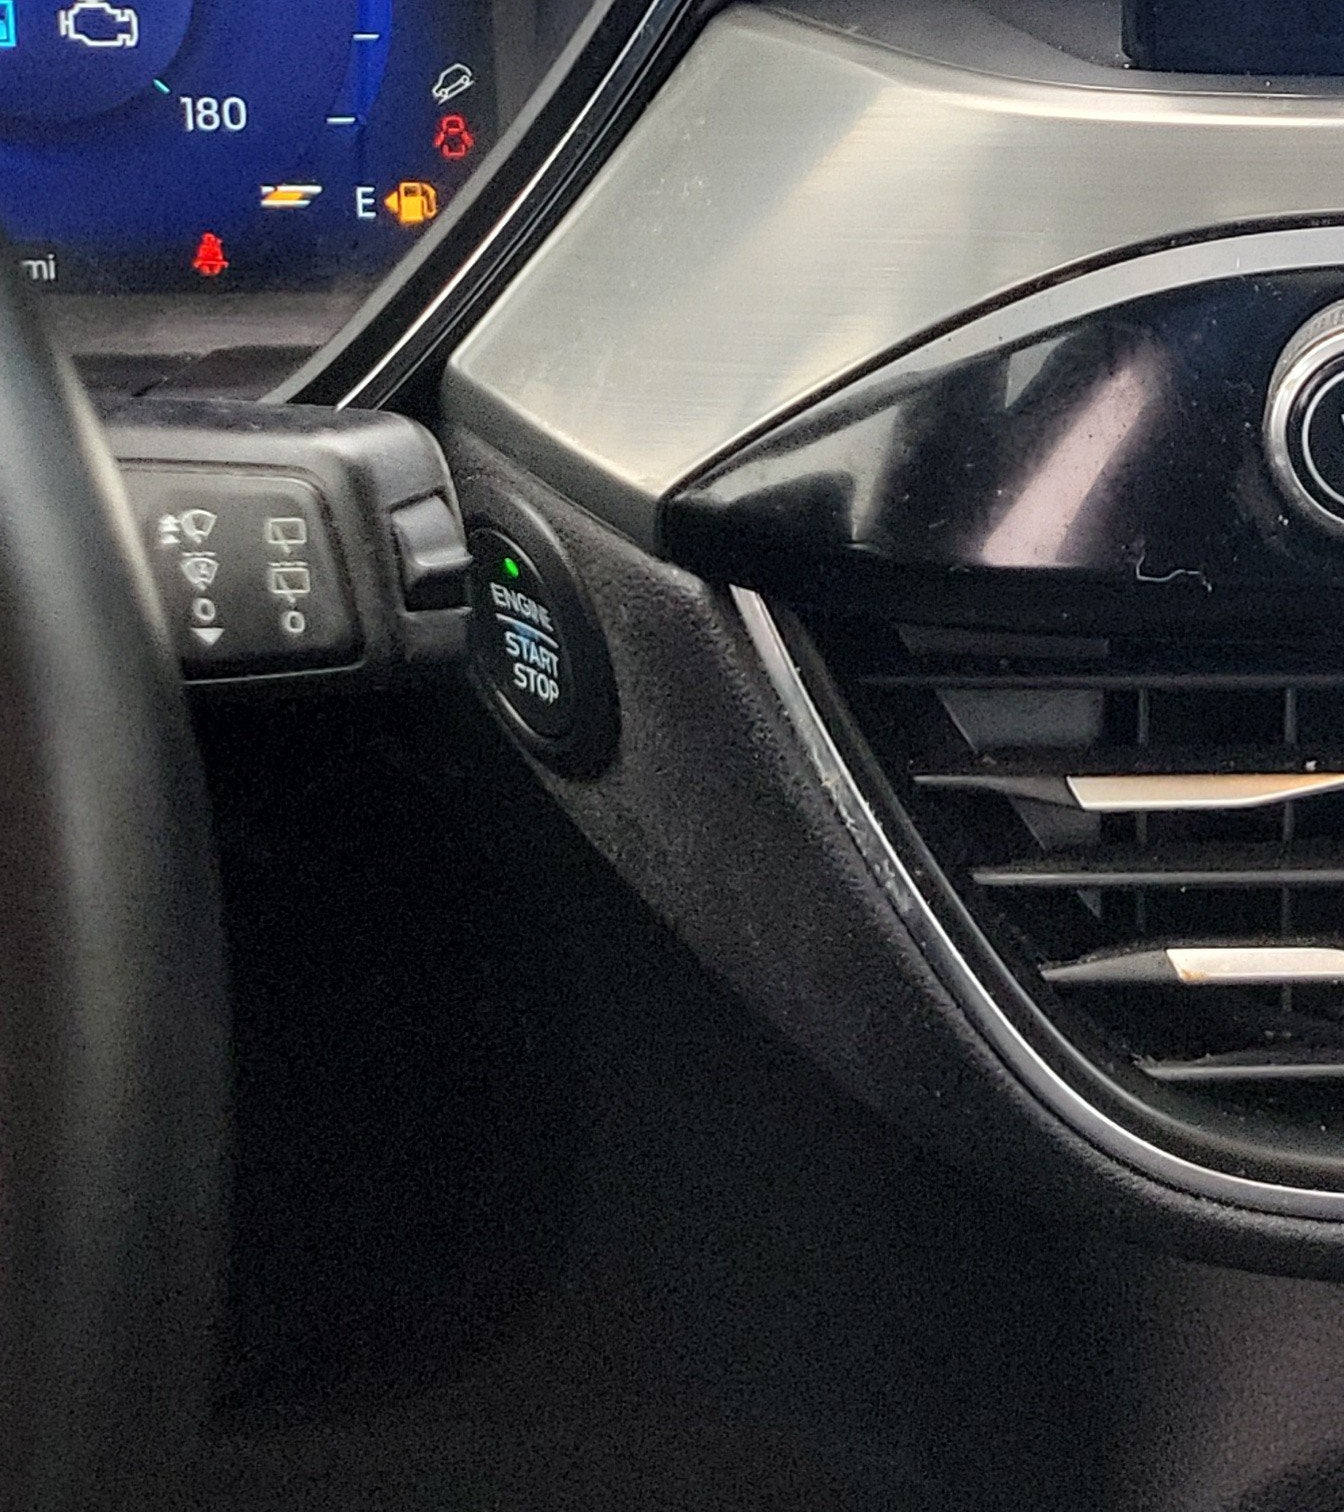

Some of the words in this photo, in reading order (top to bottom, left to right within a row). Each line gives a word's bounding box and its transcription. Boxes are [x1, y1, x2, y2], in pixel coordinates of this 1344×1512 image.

[179, 95, 248, 132] 180
[355, 186, 378, 219] E
[490, 581, 555, 633] ENGINE
[504, 630, 559, 678] START
[513, 661, 560, 704] STOP
